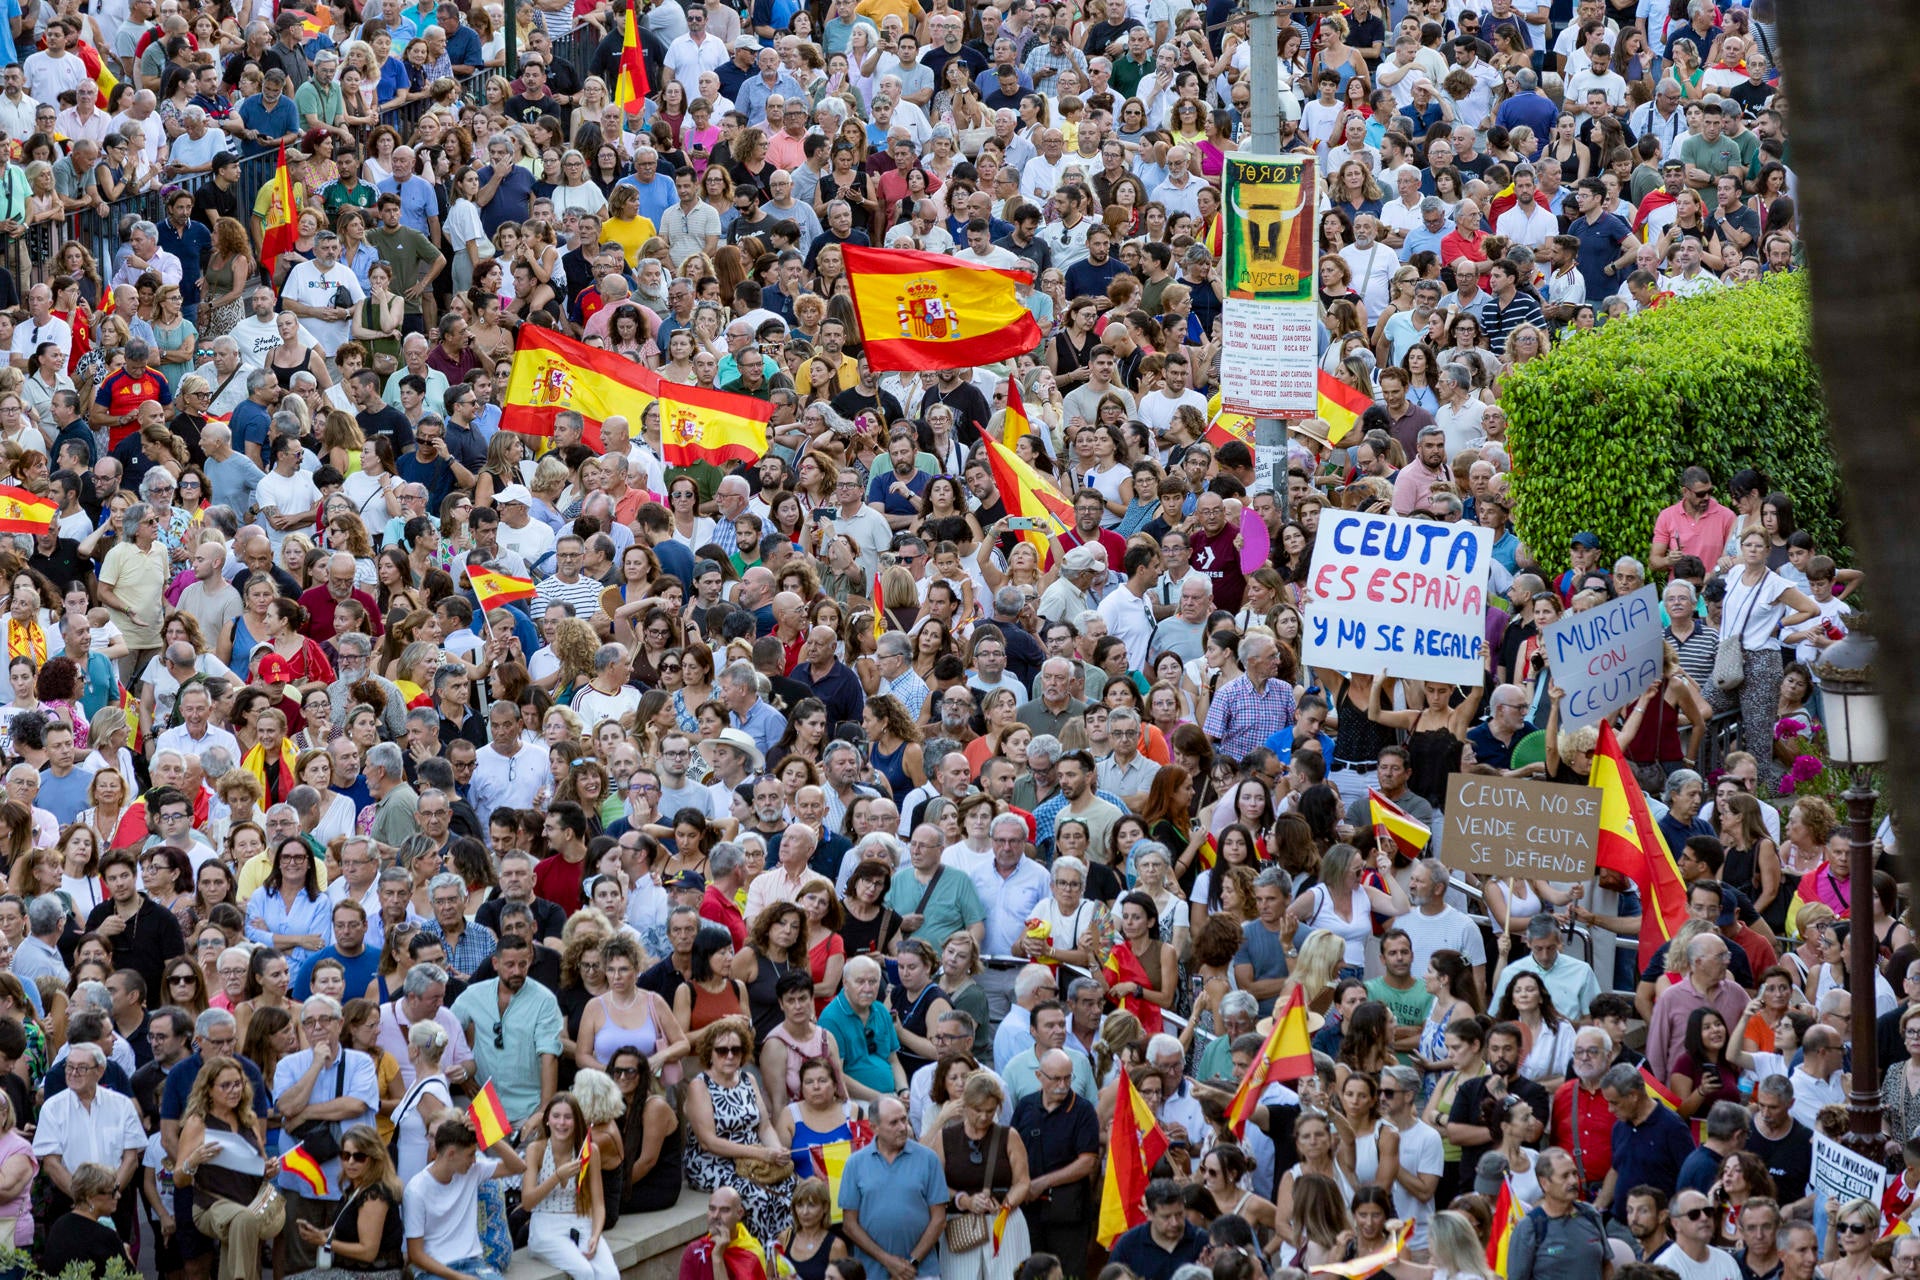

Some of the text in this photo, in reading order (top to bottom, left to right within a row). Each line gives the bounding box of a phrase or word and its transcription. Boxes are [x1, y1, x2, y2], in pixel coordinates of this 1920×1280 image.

[80, 327, 86, 341] 9
[1250, 333, 1278, 341] MANZANARES
[1253, 323, 1275, 332] MORANTE
[1282, 324, 1295, 332] PACO
[1282, 334, 1294, 342] JUAN
[1252, 343, 1276, 352] TALAVANTE
[1284, 344, 1298, 352] ROCA
[1333, 517, 1478, 574] CEUTA
[1314, 564, 1482, 615] ES ESPAÑA
[1313, 616, 1482, 660] Y NO SE REGALA
[1556, 598, 1650, 663] MURCIA
[1588, 644, 1627, 676] CON
[1569, 659, 1656, 718] CEUTA
[1459, 781, 1598, 817] CEUTA NO SE
[1455, 815, 1589, 849] VENDE CEUTA
[1470, 842, 1587, 873] SE DEFIENDE
[1831, 1150, 1841, 1165] LA
